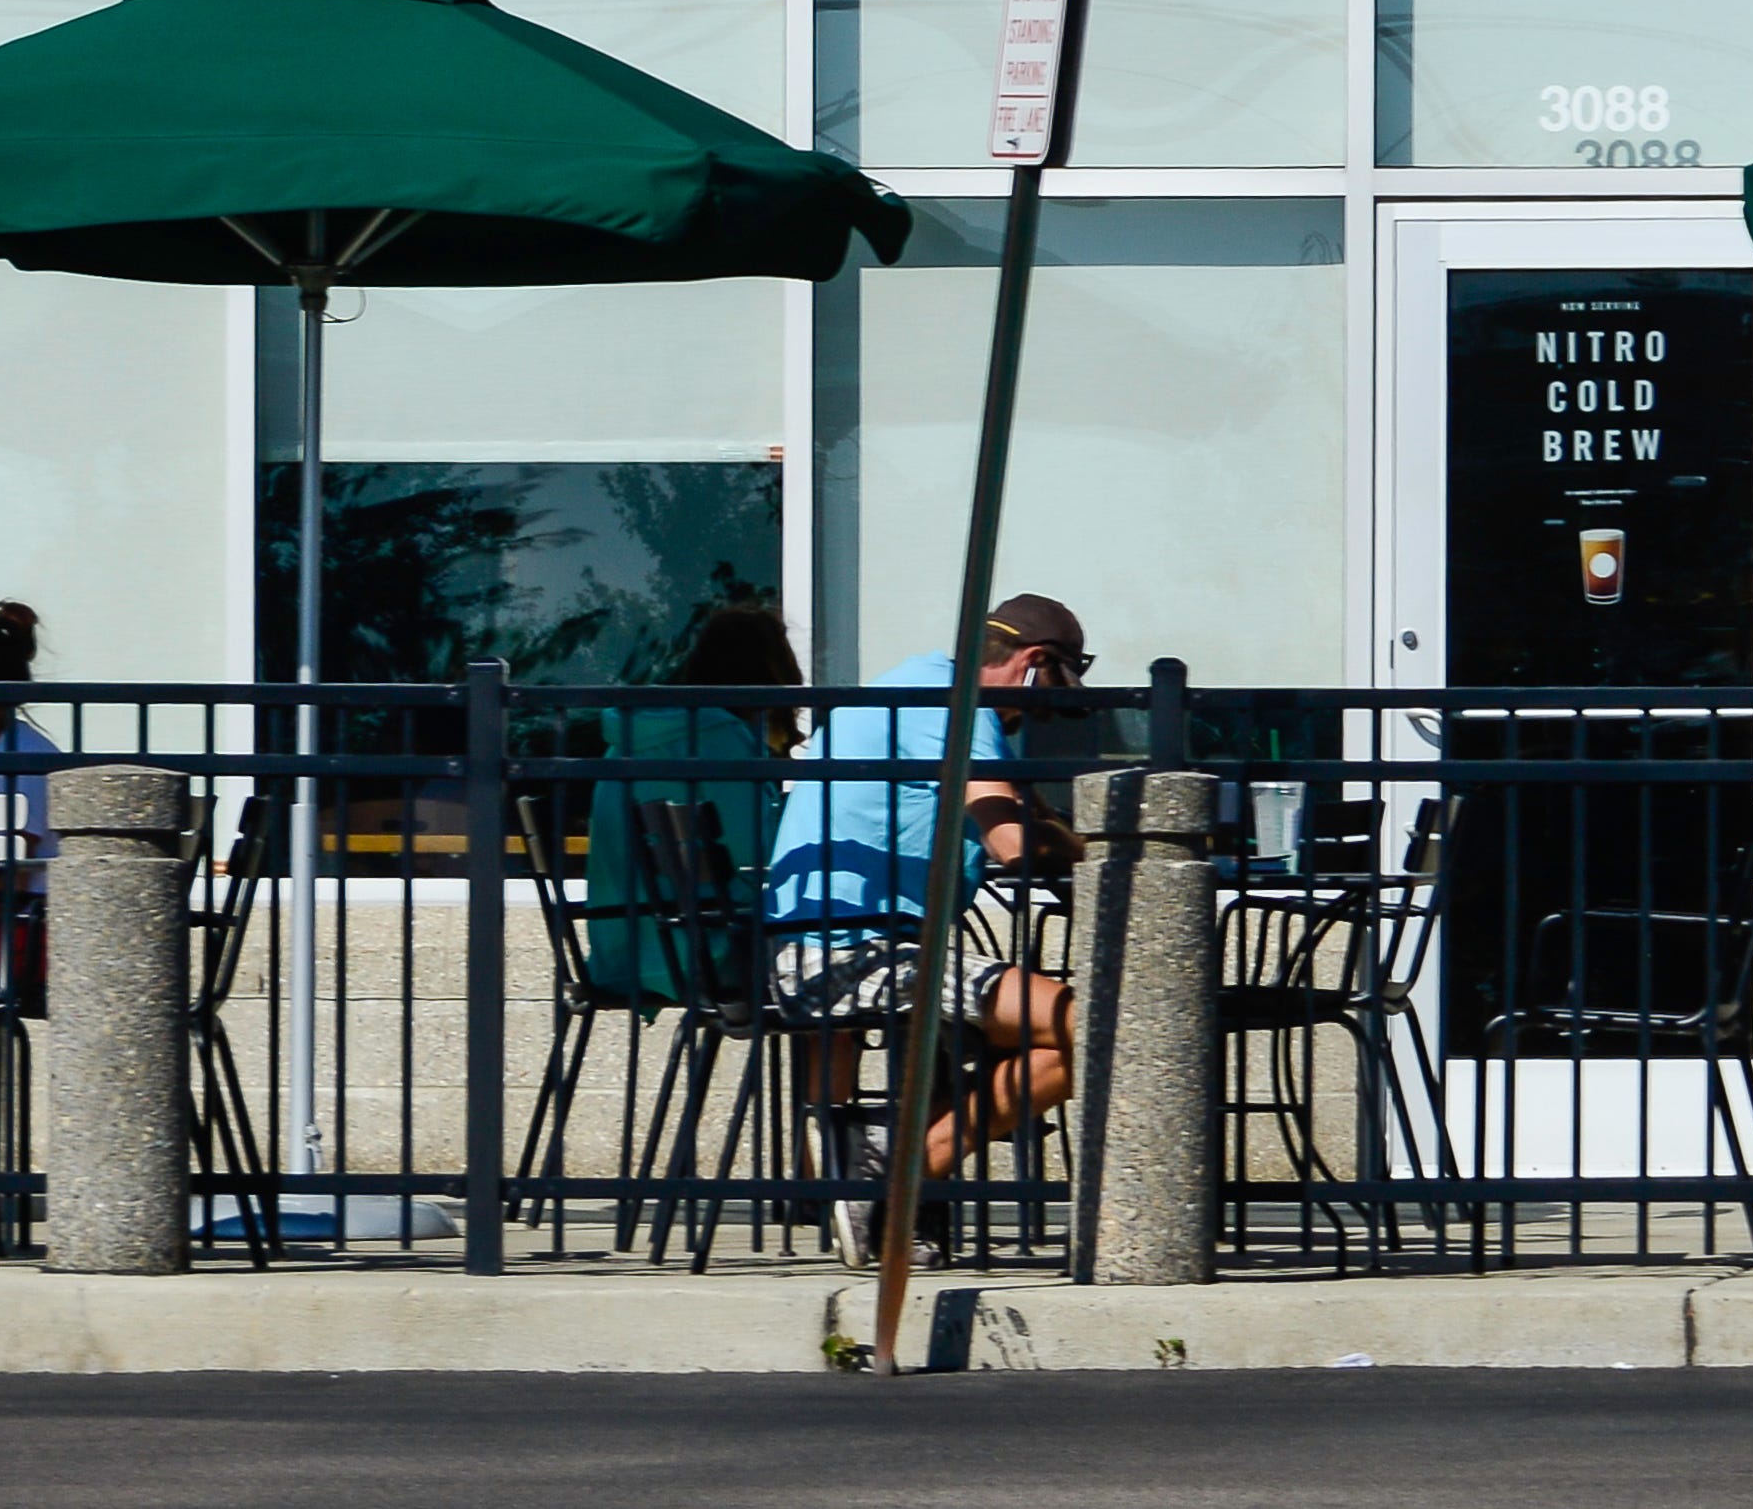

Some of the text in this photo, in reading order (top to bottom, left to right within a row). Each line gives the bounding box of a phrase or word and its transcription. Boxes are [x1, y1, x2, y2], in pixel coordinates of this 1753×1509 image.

[1537, 84, 1671, 133] 3088
[1536, 330, 1666, 364] NITRO
[1547, 379, 1655, 413] COLD
[1542, 428, 1661, 463] BREW
